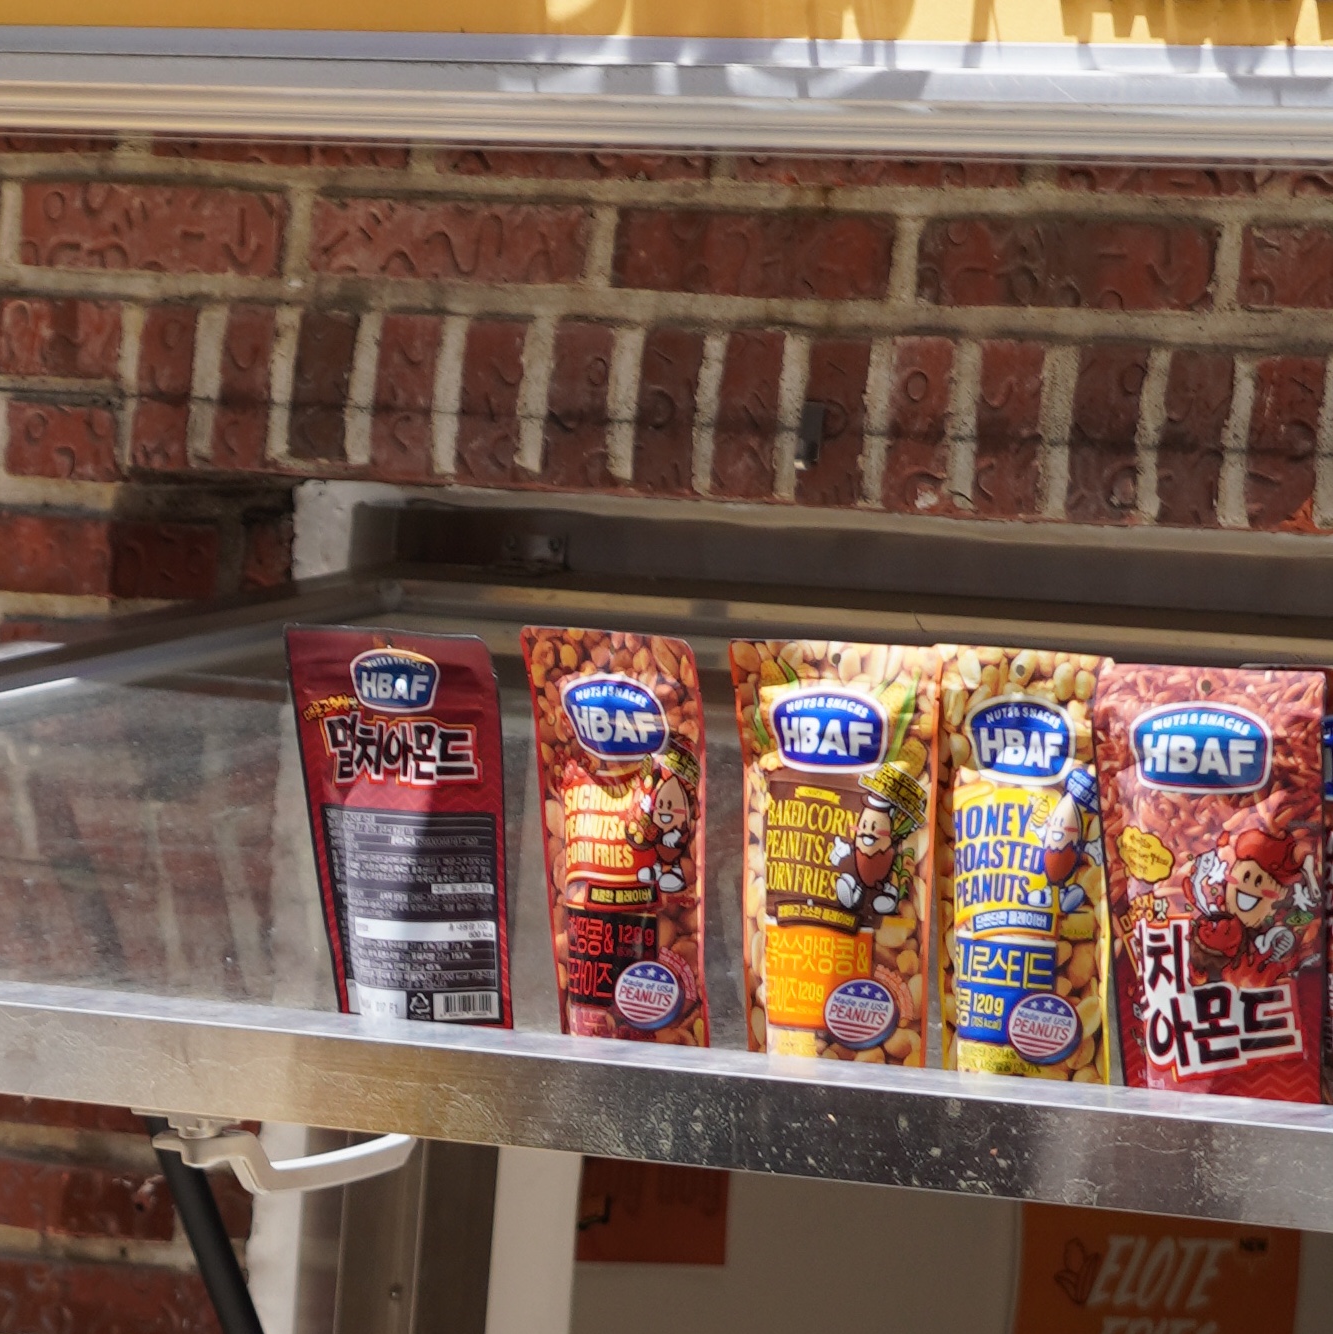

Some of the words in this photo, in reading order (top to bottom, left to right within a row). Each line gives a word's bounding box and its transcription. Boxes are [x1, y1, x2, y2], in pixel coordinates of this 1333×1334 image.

[361, 671, 430, 701] HBAF
[571, 704, 658, 743] HBAF
[780, 716, 874, 757] HBAF
[1199, 712, 1251, 736] SNACKS
[324, 712, 476, 781] 멸치아몬드
[979, 727, 1064, 769] HBAF
[1142, 733, 1257, 777] HBAF
[768, 799, 806, 827] BAKED
[807, 802, 859, 838] CORN
[953, 802, 1033, 843] HONEY
[566, 841, 594, 868] CORN
[595, 844, 634, 868] FRIES
[954, 840, 1046, 876] ROASTED
[794, 863, 841, 900] FRIES
[956, 872, 1030, 908] PEANUTS
[619, 985, 673, 1006] PEANUTS
[622, 976, 643, 988] Made
[645, 980, 655, 991] of
[657, 982, 674, 994] USA
[829, 1002, 886, 1026] PEANUTS
[834, 995, 856, 1006] Made
[858, 998, 869, 1010] of
[870, 1000, 889, 1013] USA
[973, 991, 1004, 1017] 120g
[1016, 1009, 1038, 1021] Made
[1041, 1013, 1052, 1024] of
[1053, 1015, 1072, 1027] USA
[1012, 1017, 1070, 1041] PEANUTS
[1148, 984, 1296, 1067] 아몬드
[1086, 1233, 1236, 1311] ELOTE
